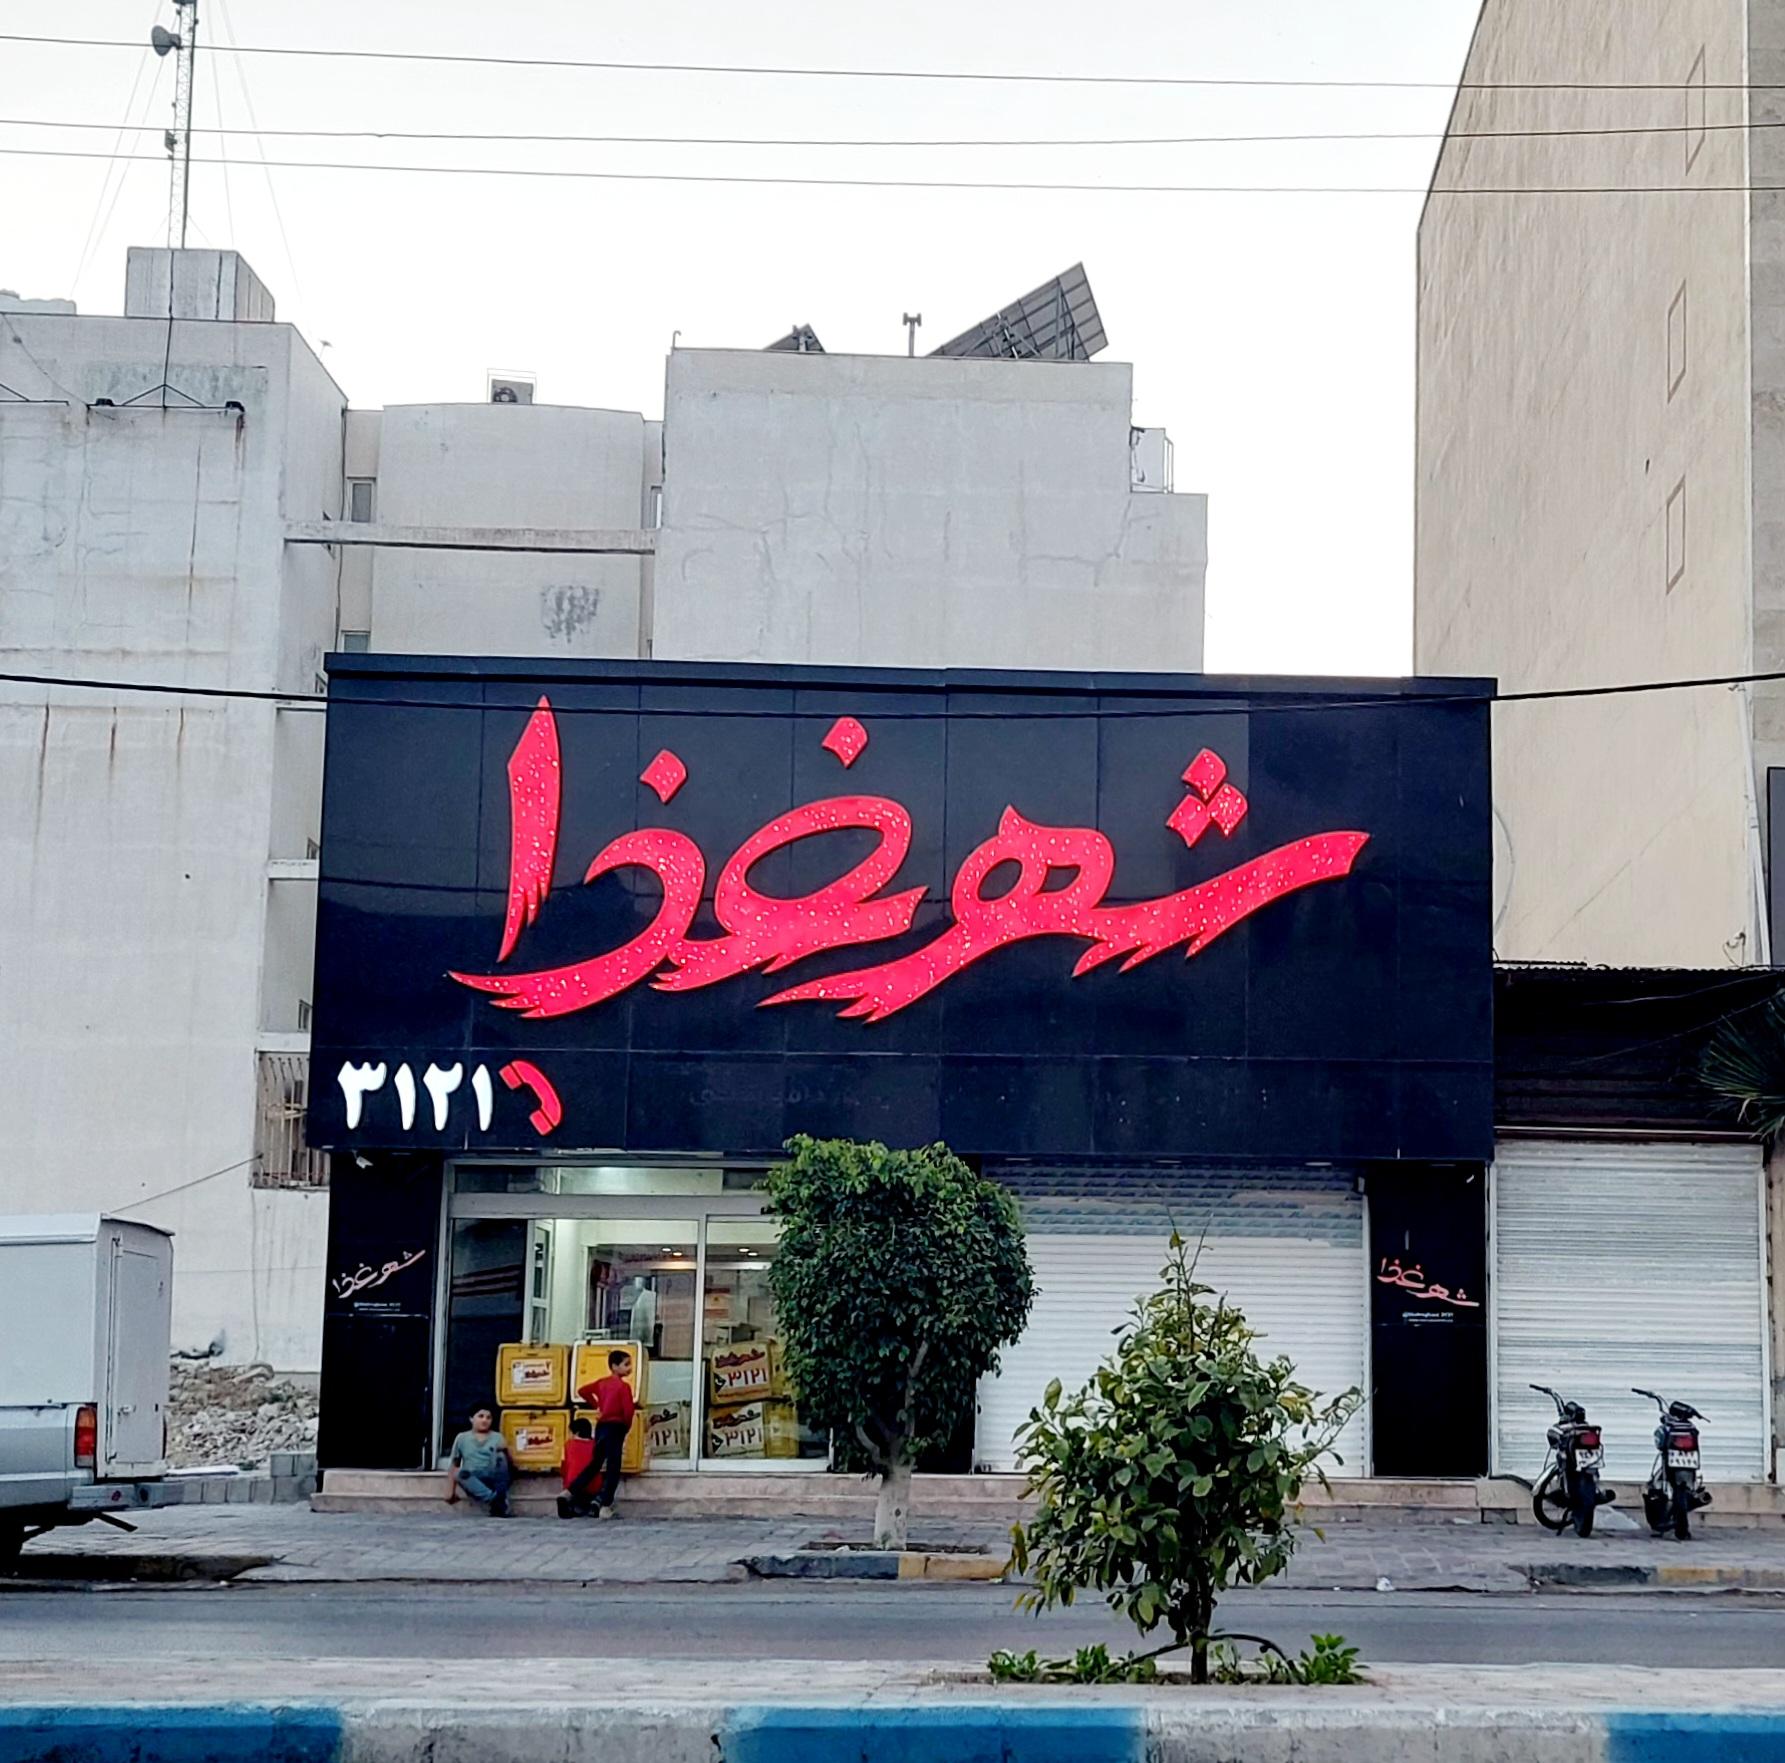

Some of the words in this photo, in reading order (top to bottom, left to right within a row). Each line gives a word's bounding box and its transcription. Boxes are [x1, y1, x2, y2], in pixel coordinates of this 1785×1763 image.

[452, 695, 927, 1018] غذا
[761, 750, 1369, 1022] شهر
[337, 1061, 493, 1132] ۳۱۲۱
[331, 1262, 379, 1299] غذا
[367, 1249, 426, 1289] شهر
[1376, 1257, 1427, 1290] غذا
[1405, 1283, 1480, 1308] شهر
[727, 1367, 767, 1387] ۳۱۲۱
